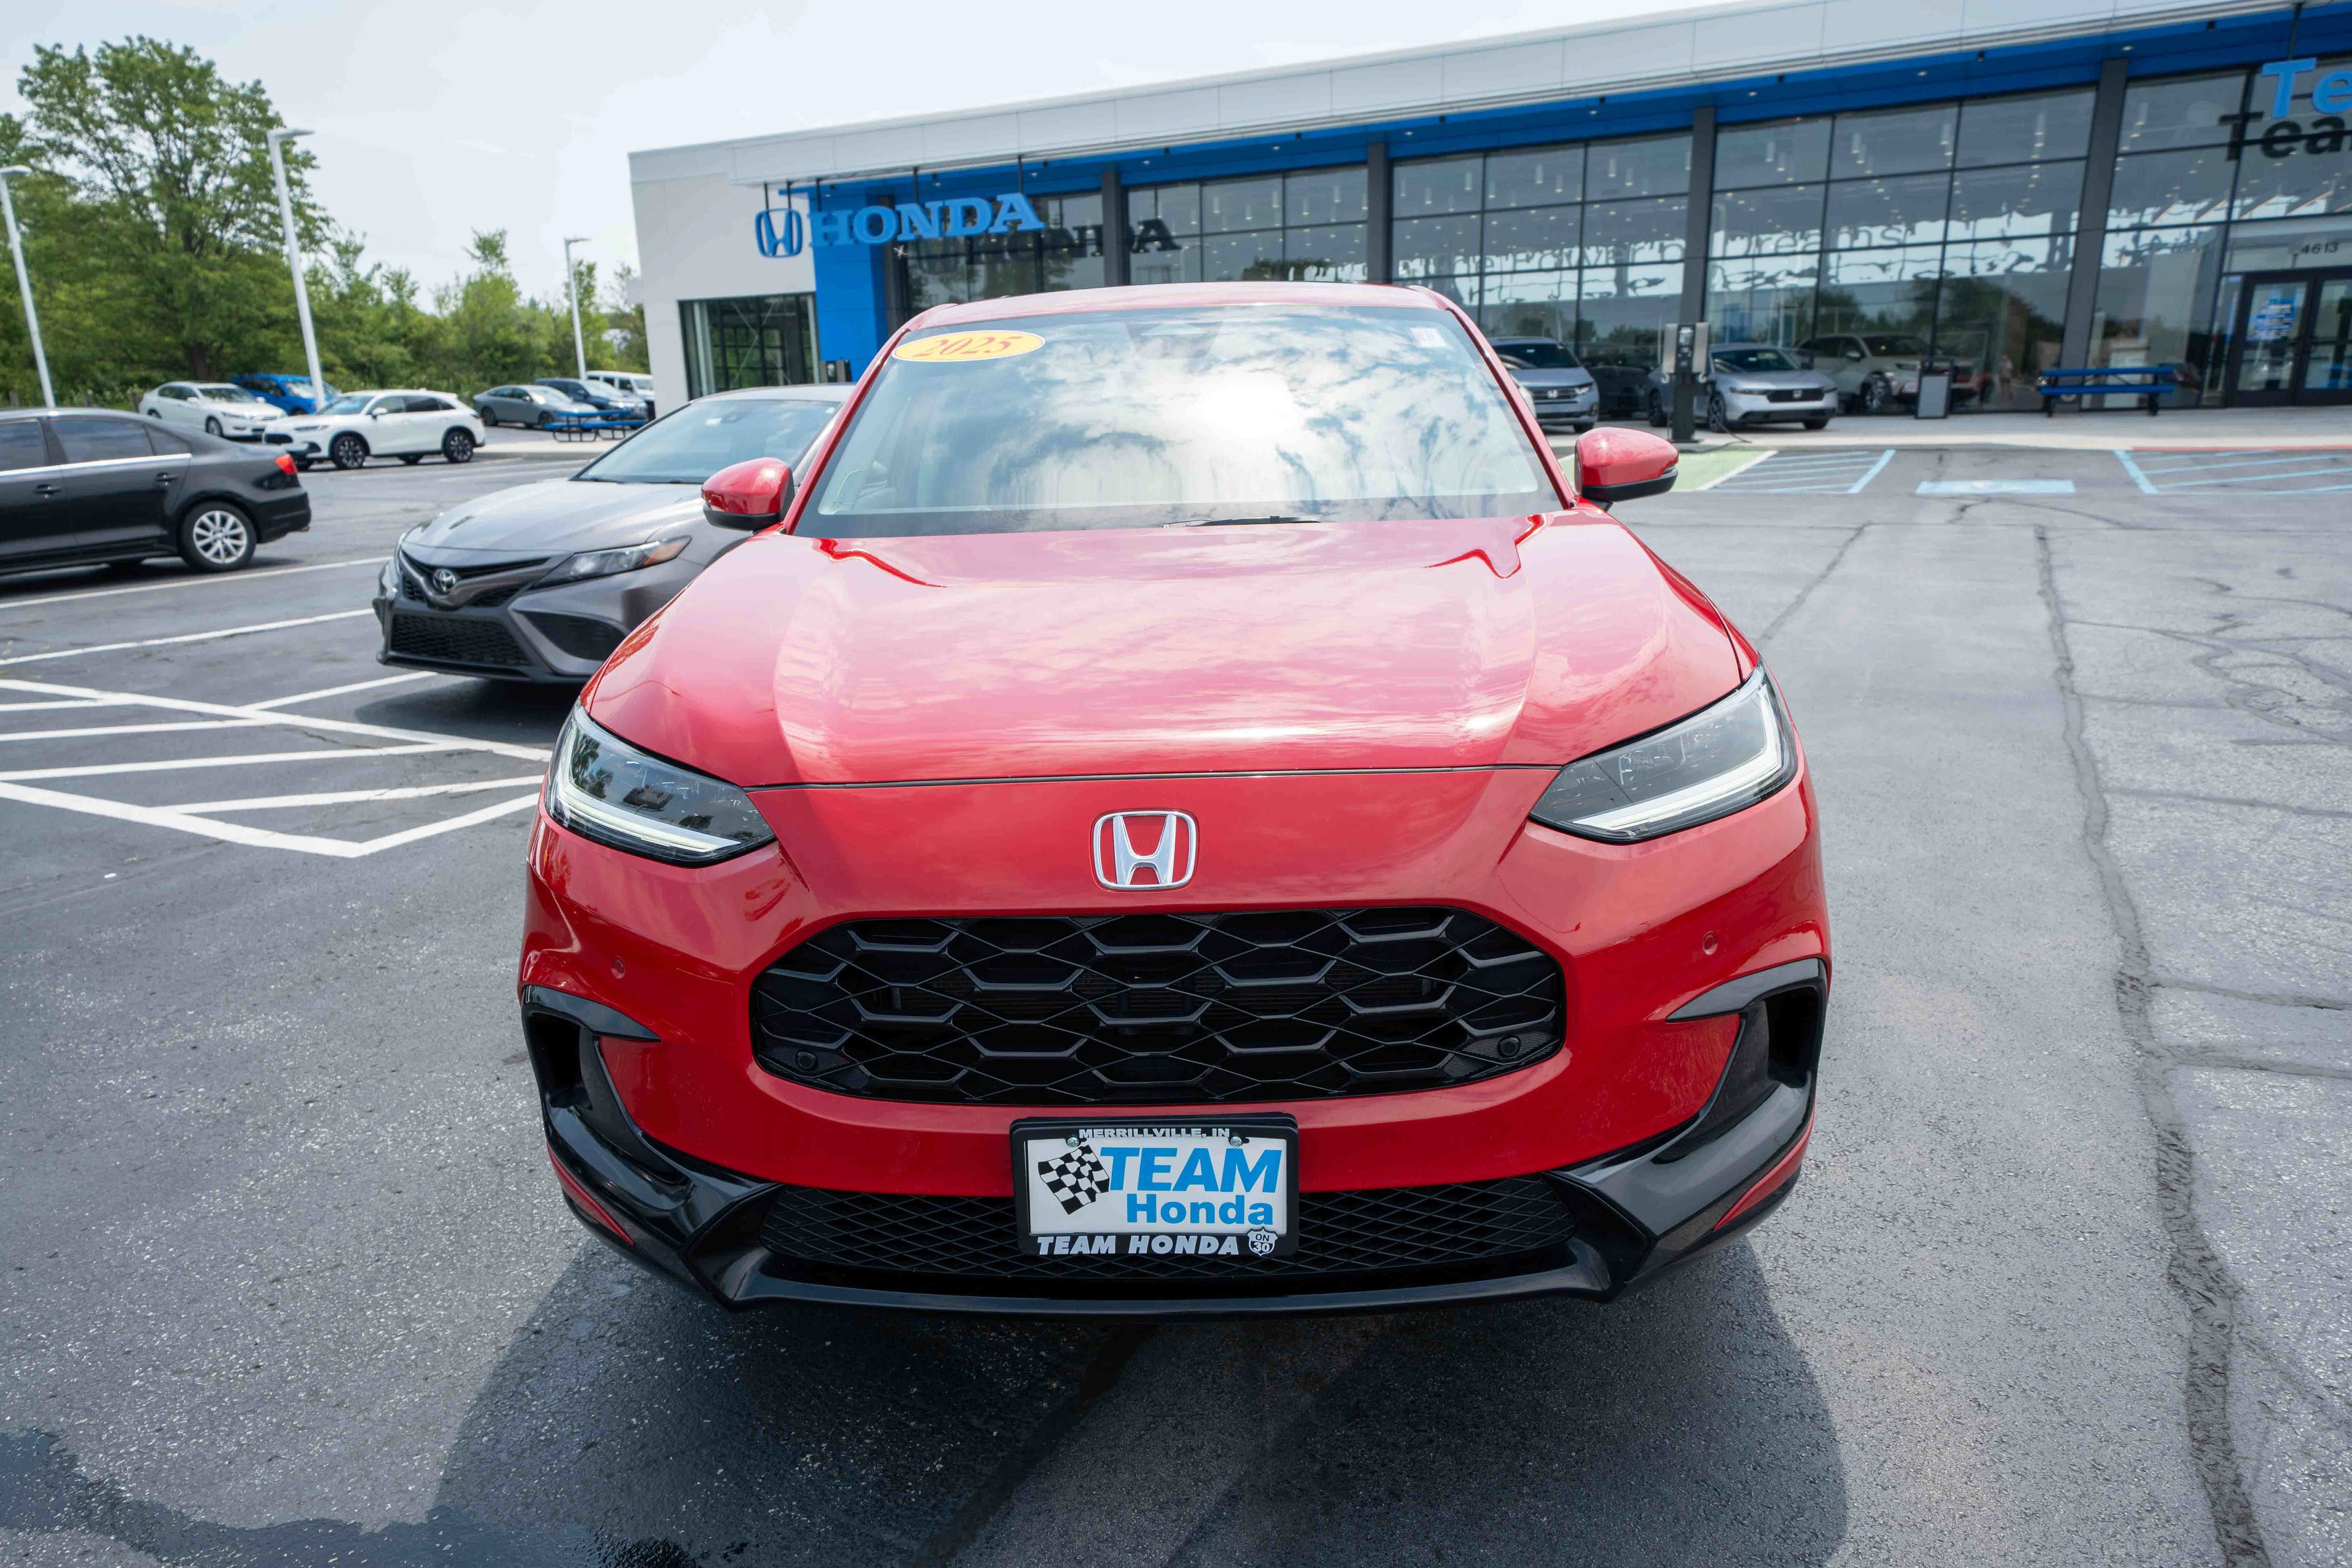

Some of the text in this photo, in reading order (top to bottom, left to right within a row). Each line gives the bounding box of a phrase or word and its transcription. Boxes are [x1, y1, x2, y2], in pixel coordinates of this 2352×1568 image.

[807, 193, 1046, 246] HONDA
[2301, 241, 2339, 254] 4613
[914, 336, 1023, 357] 2025
[1079, 1128, 1230, 1138] MERRILLVILLE, IN
[1100, 1147, 1282, 1193] TEAM
[1127, 1194, 1274, 1225] Honda
[1037, 1235, 1239, 1255] TEAM HONDA
[1253, 1243, 1269, 1253] 30
[1255, 1234, 1270, 1242] ON
